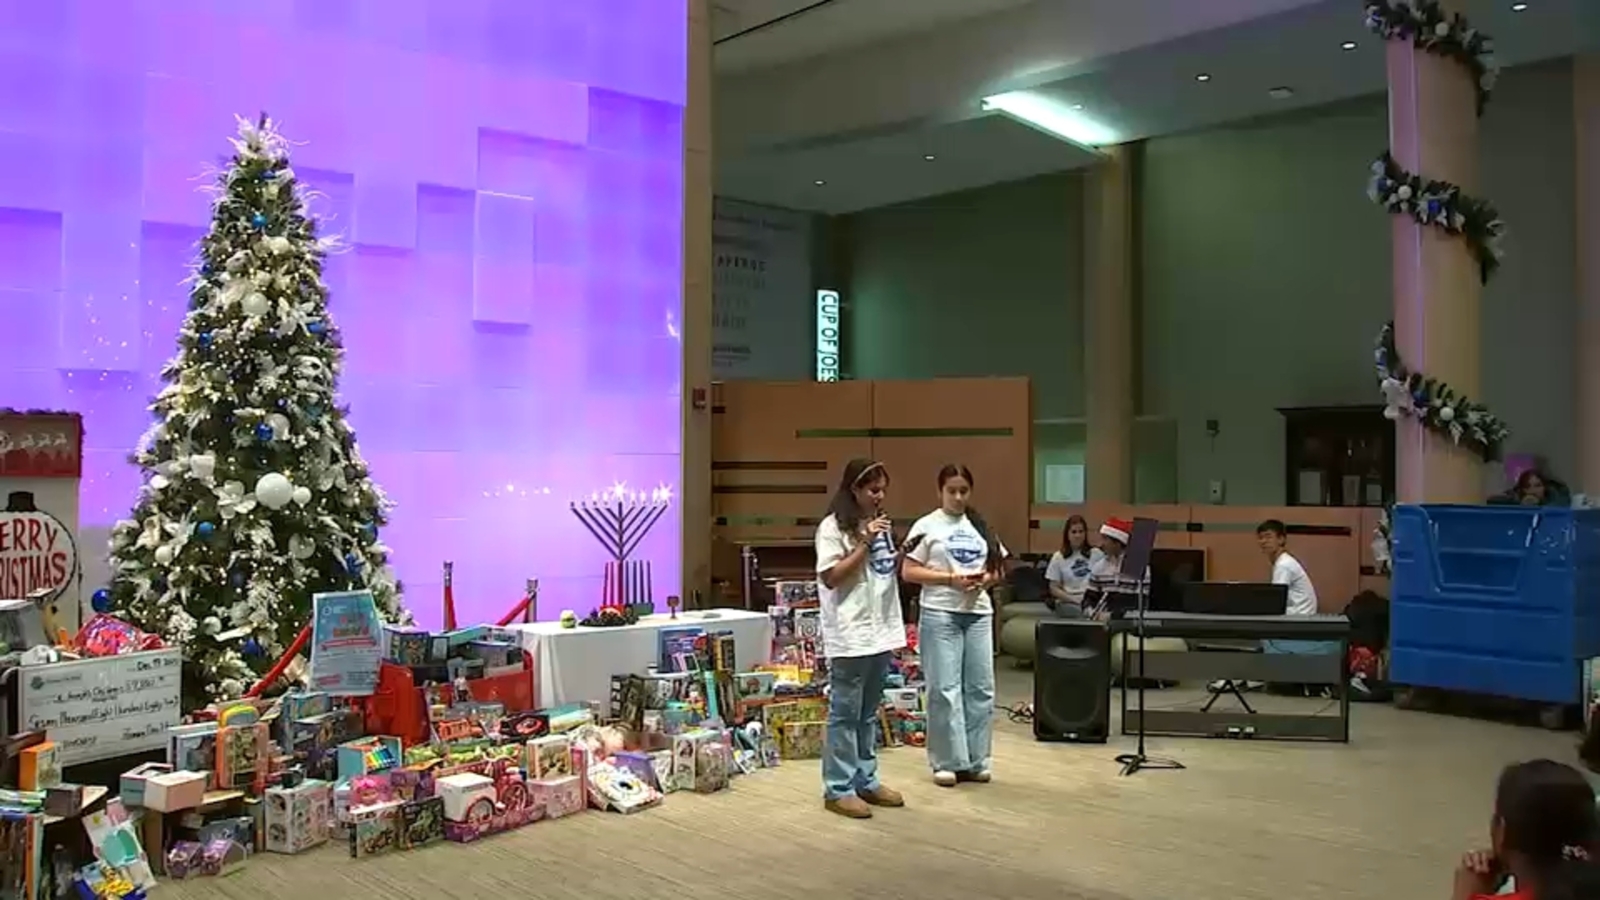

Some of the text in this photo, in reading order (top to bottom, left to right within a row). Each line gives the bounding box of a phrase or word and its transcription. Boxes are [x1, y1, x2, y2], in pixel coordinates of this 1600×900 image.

[821, 294, 838, 324] CUP
[821, 328, 838, 347] OF
[0, 518, 57, 552] ERRY
[0, 552, 67, 600] RISTMAS
